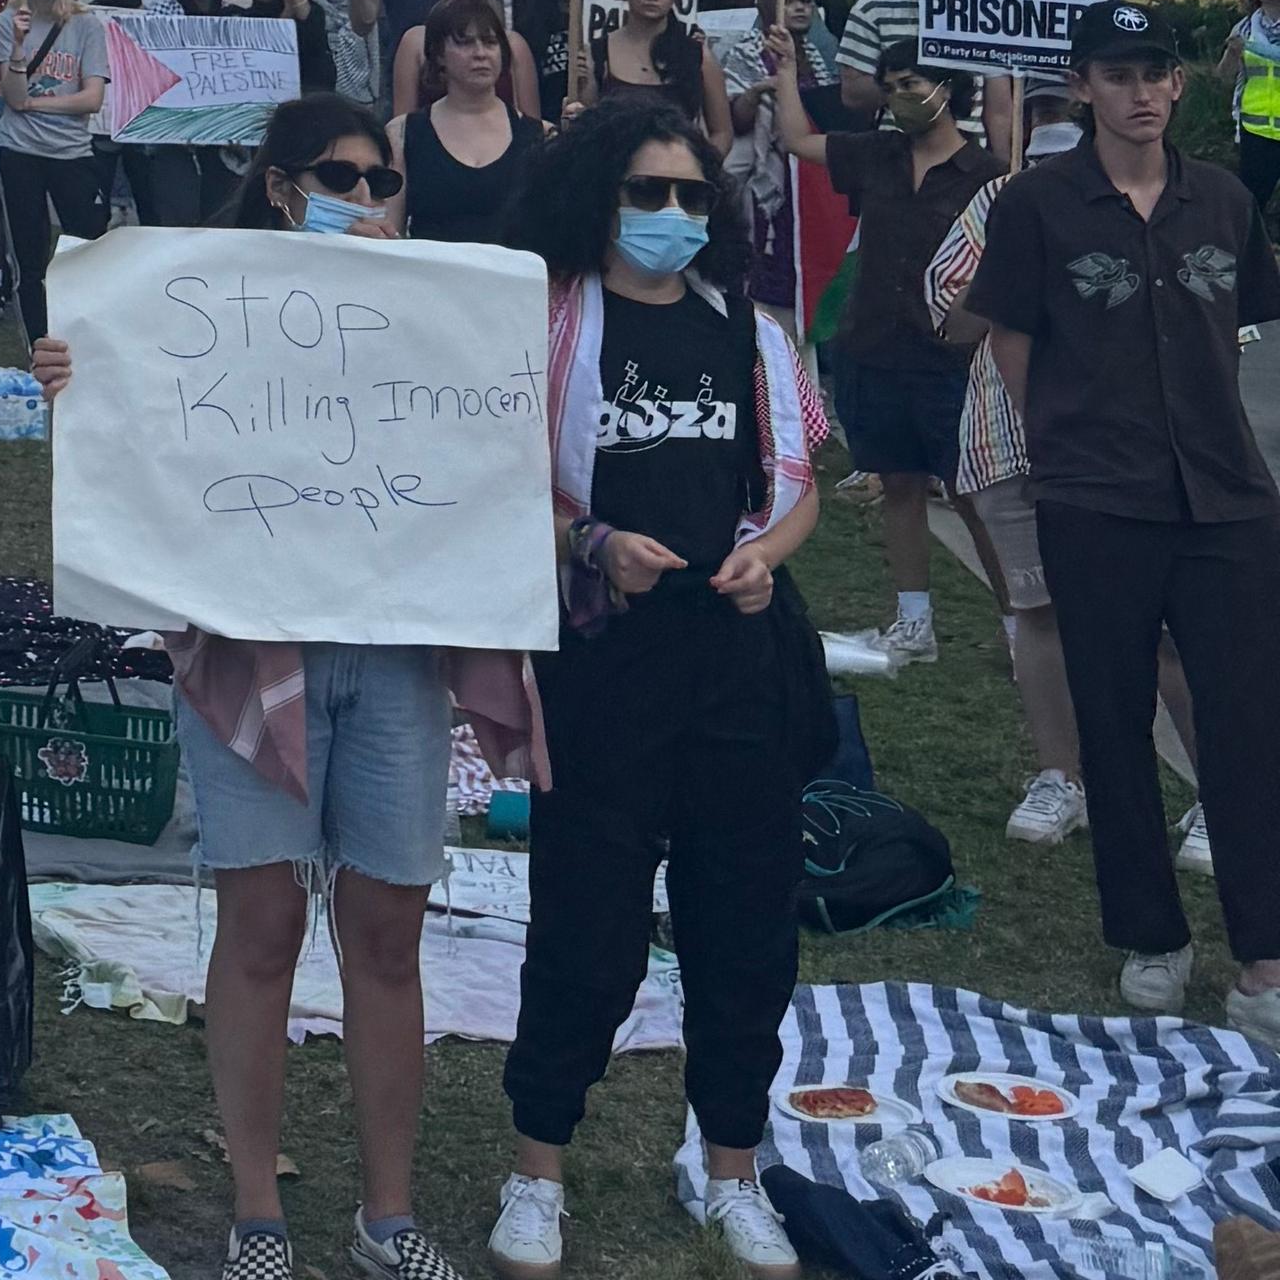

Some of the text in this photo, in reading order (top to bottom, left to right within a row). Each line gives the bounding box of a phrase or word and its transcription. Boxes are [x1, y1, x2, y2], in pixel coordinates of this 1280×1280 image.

[191, 51, 258, 70] FREE
[944, 45, 970, 58] Party
[972, 48, 987, 57] for
[1039, 55, 1058, 64] and
[186, 71, 290, 100] PALESTINE
[177, 350, 544, 465] Killing Innocent
[597, 400, 737, 447] gaza
